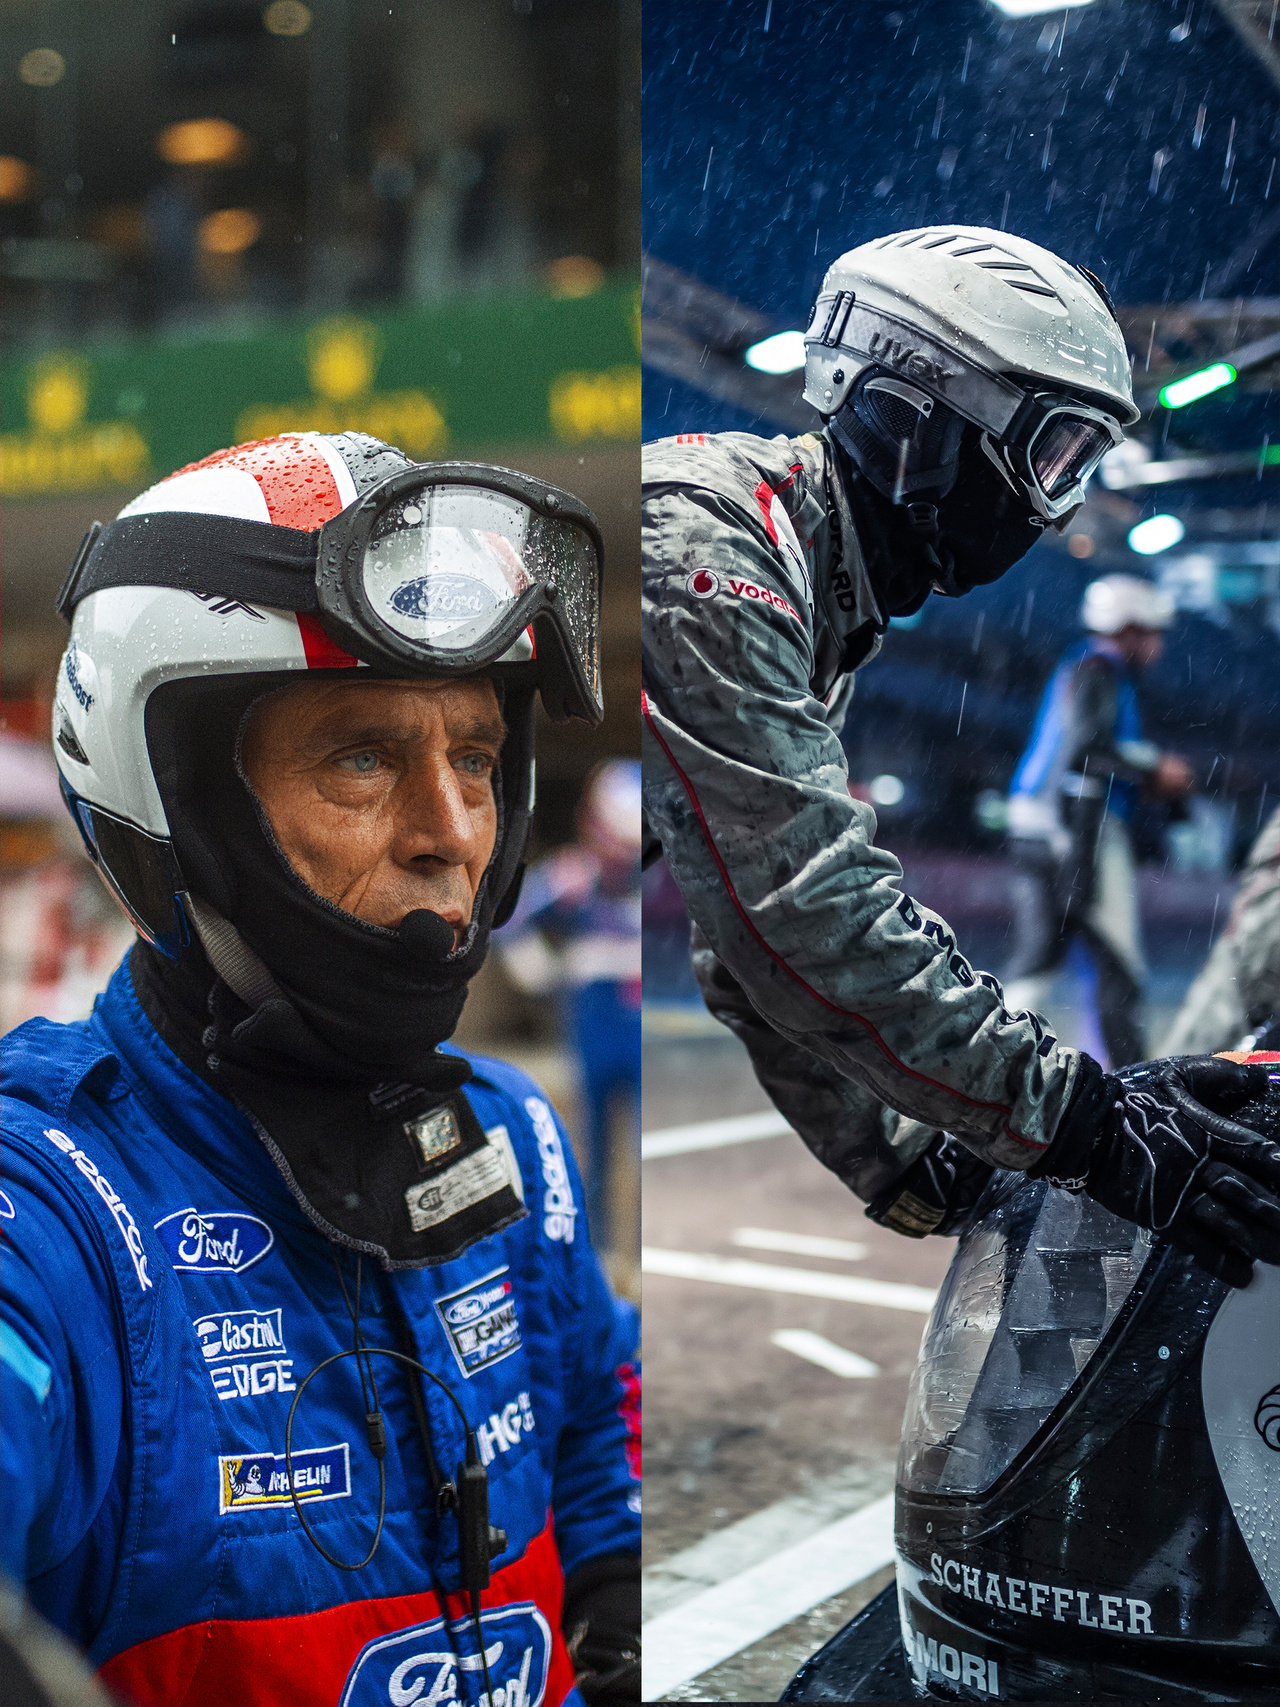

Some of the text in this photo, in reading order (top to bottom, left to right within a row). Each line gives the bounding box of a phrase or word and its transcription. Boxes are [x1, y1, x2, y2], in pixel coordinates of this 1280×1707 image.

[868, 331, 957, 394] uvex
[417, 580, 484, 614] Ford
[178, 1214, 244, 1265] Ford
[209, 1359, 297, 1400] EDGE
[930, 1552, 1155, 1634] SCHAEFFLER
